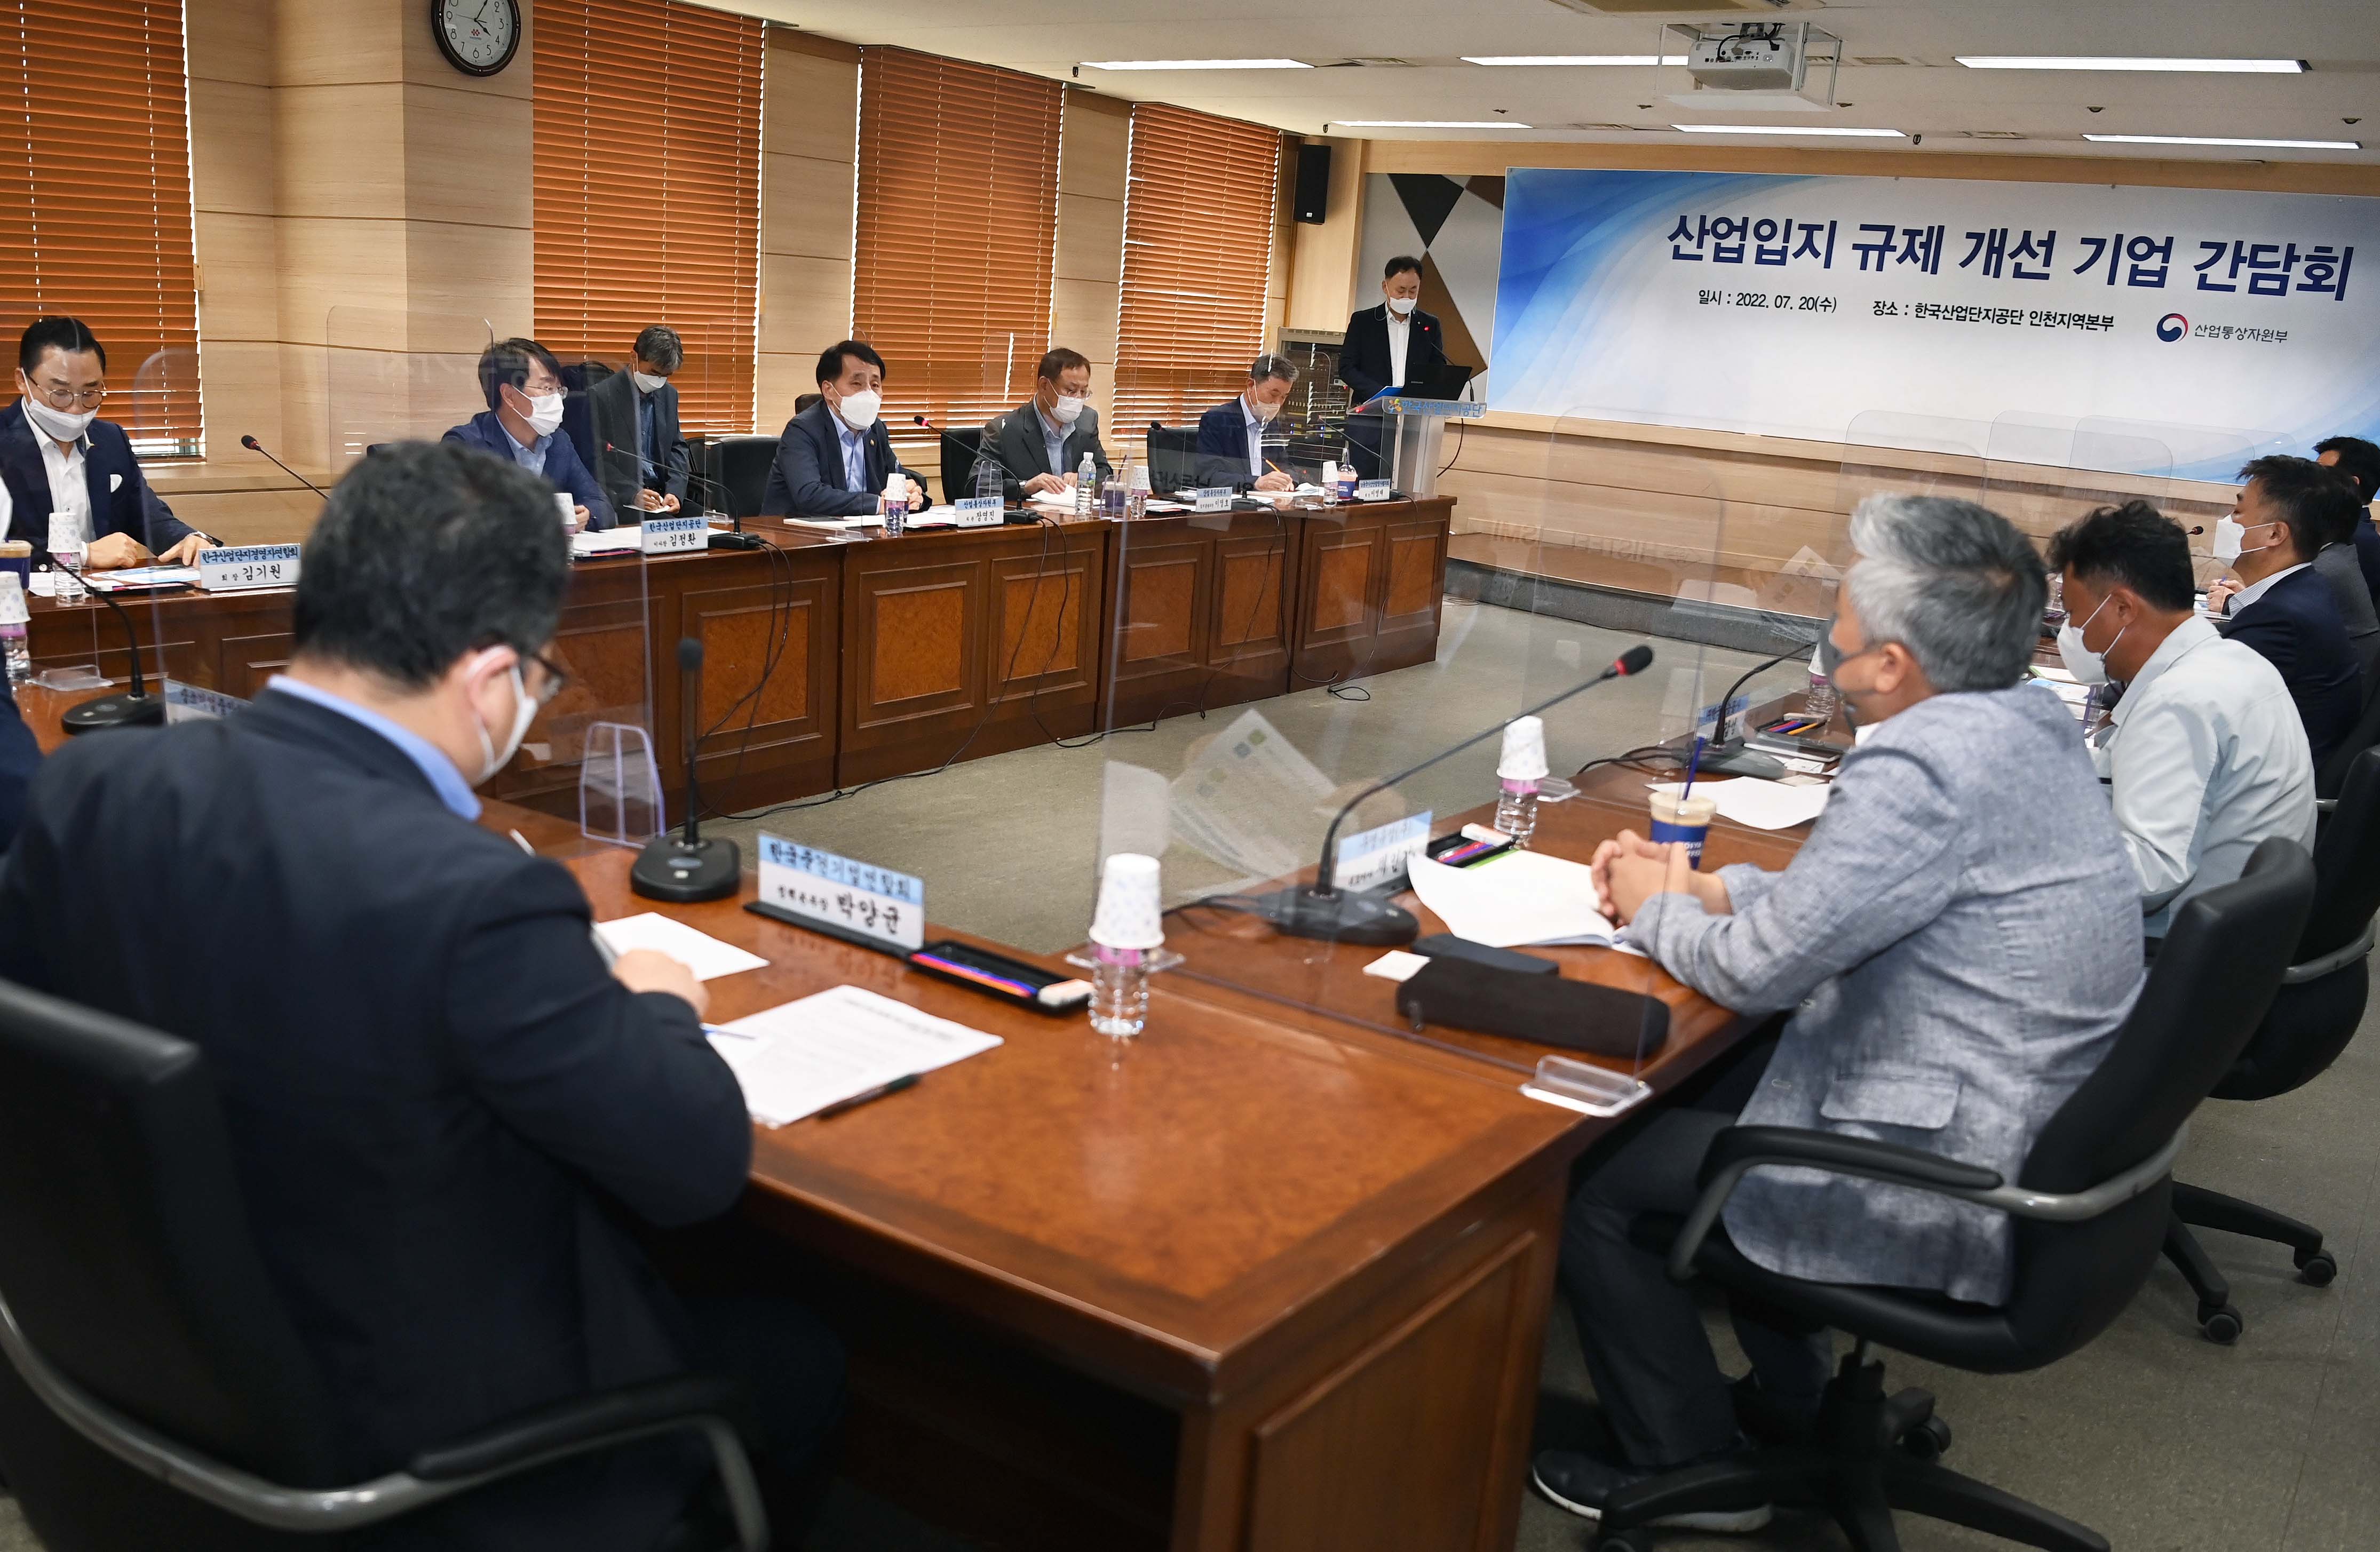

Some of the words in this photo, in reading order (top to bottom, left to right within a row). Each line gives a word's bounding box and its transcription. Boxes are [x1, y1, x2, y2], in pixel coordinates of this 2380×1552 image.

[494, 1, 499, 12] 2
[446, 11, 453, 22] 9
[498, 18, 504, 29] 3
[450, 28, 457, 39] 8
[495, 35, 500, 45] 4
[461, 42, 465, 52] 7
[473, 47, 479, 59] 6
[486, 45, 491, 55] 5
[1667, 215, 1837, 269] 산업입지
[1852, 224, 1945, 275] 규제
[1958, 228, 2056, 280] 개선
[2073, 234, 2174, 288] 기업
[2193, 240, 2354, 301] 간담회
[1699, 290, 1722, 305] 일시
[1735, 292, 1769, 308] 2022.
[1774, 295, 1793, 310] 07.
[1798, 296, 1837, 313] 20(수)
[1873, 300, 1899, 316] 장소
[1915, 302, 2025, 325] 한국산업단지공단
[2029, 310, 2114, 332] 인천지역본부
[2194, 324, 2288, 343] 산업통상자원부
[964, 498, 996, 509] 산업통상자원부
[976, 510, 994, 522] 장영진
[649, 519, 702, 532] 한국산업단지공단
[670, 532, 696, 547] 김정환
[202, 546, 298, 563] 한국산업단지경영자연합회
[243, 563, 281, 580] 김기원
